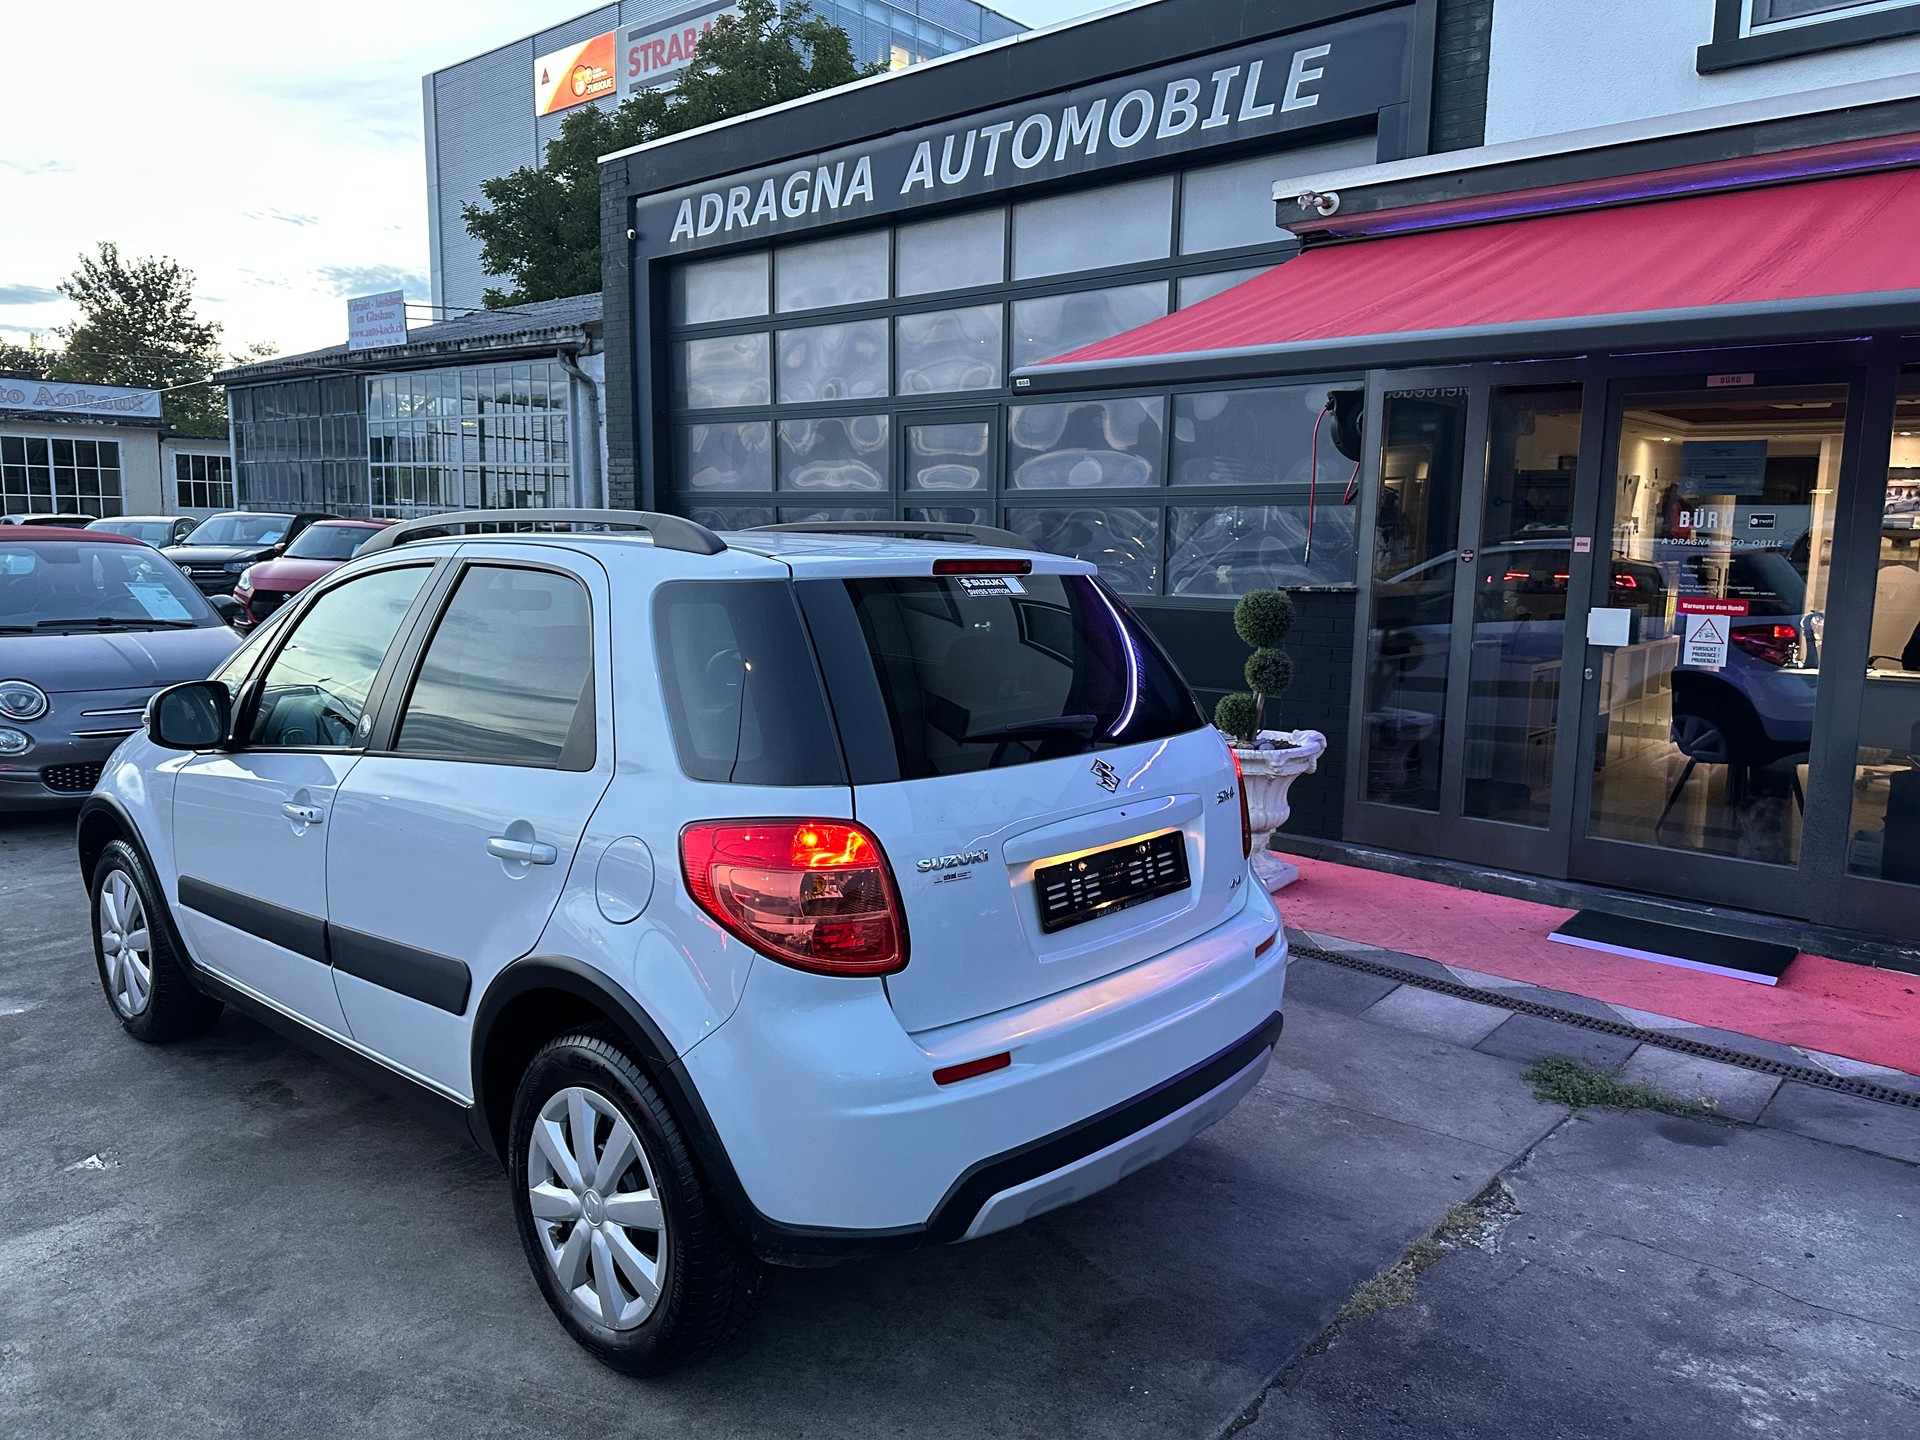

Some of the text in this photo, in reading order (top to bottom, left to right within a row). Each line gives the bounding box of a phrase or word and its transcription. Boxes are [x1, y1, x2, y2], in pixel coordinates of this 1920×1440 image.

[587, 78, 613, 95] ZURIQUE
[669, 44, 1331, 243] ADRAGNA AUTOMOBILE
[351, 322, 403, 338] www.auto-koch.ch
[1720, 375, 1741, 384] BÜRO
[1679, 508, 1734, 529] BÜRO
[1682, 602, 1705, 610] Warnung
[916, 848, 989, 873] SUZUKI
